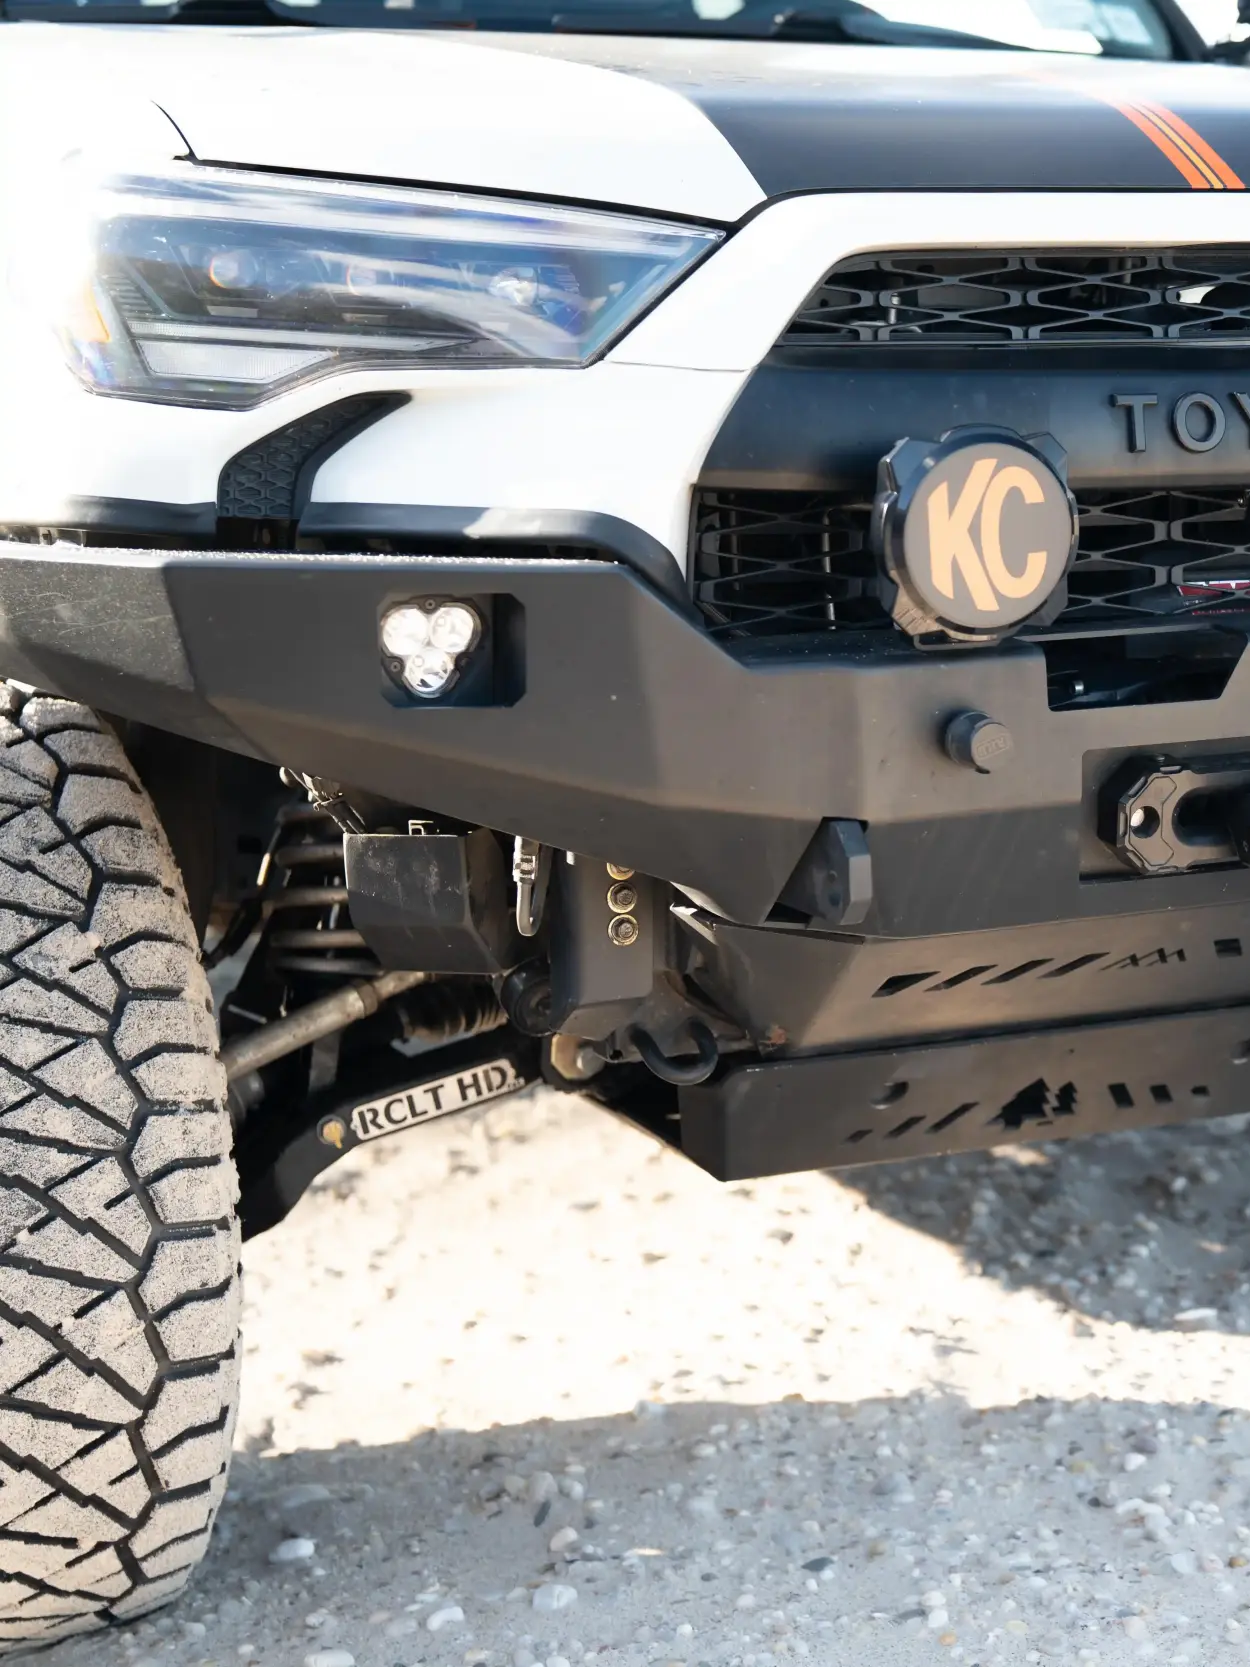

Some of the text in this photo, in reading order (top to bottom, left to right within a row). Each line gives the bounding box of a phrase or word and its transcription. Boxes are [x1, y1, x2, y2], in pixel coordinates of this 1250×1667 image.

[927, 458, 1048, 611] KC
[357, 1065, 508, 1134] RCLT HD
